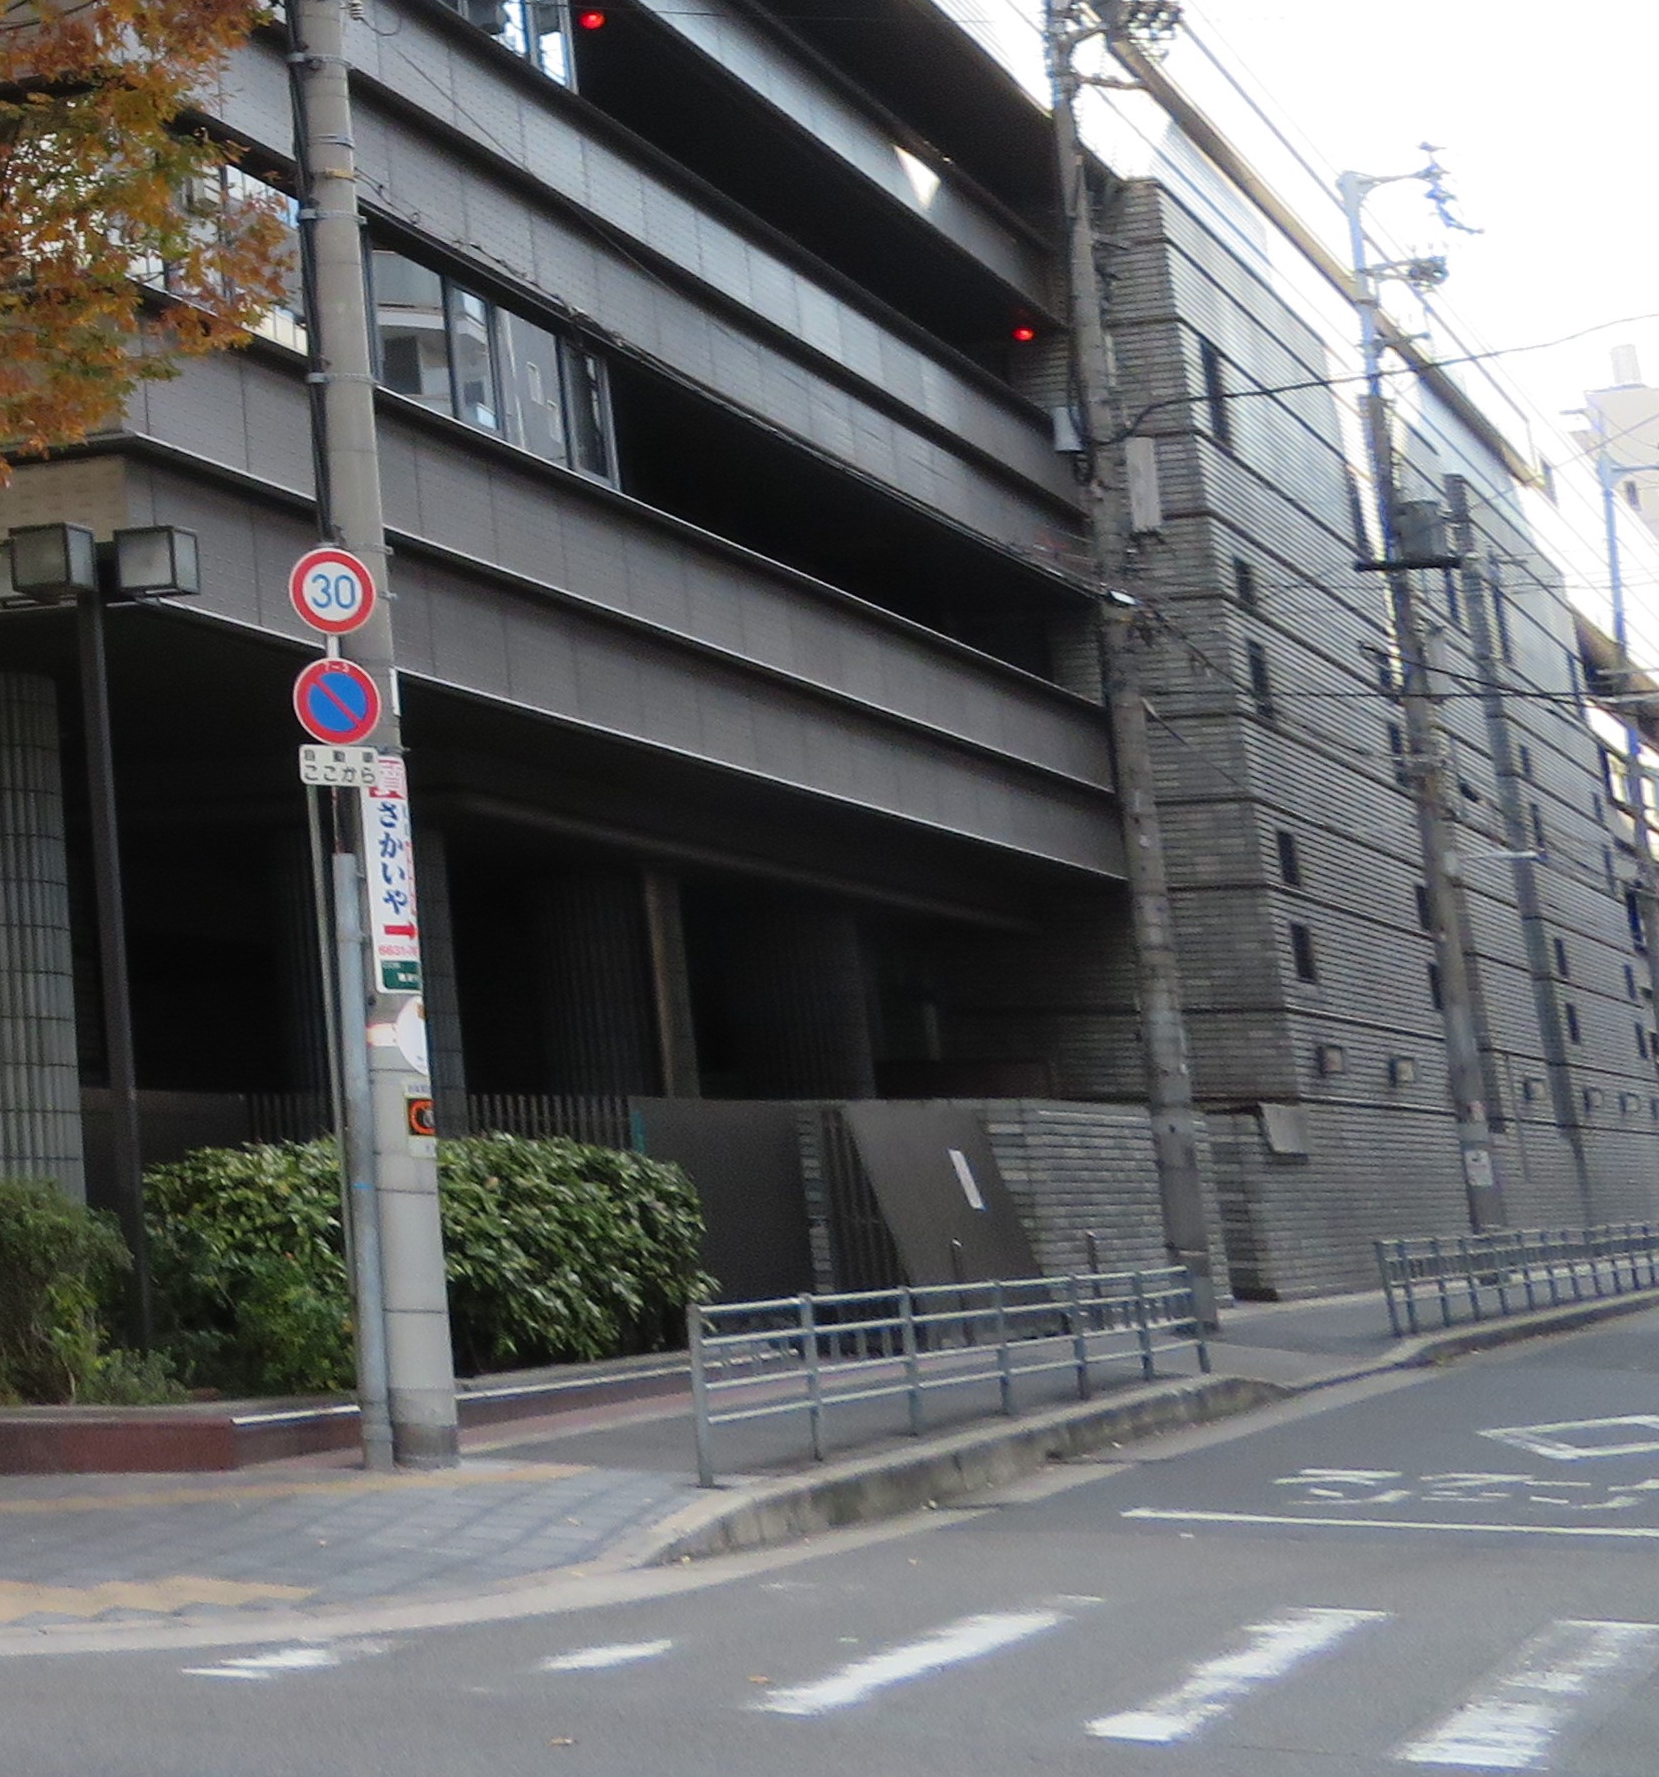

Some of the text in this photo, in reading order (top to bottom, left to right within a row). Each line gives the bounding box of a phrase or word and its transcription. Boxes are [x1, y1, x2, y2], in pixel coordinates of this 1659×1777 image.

[311, 573, 356, 609] 30
[304, 764, 375, 785] ここから
[377, 801, 408, 916] さかいや
